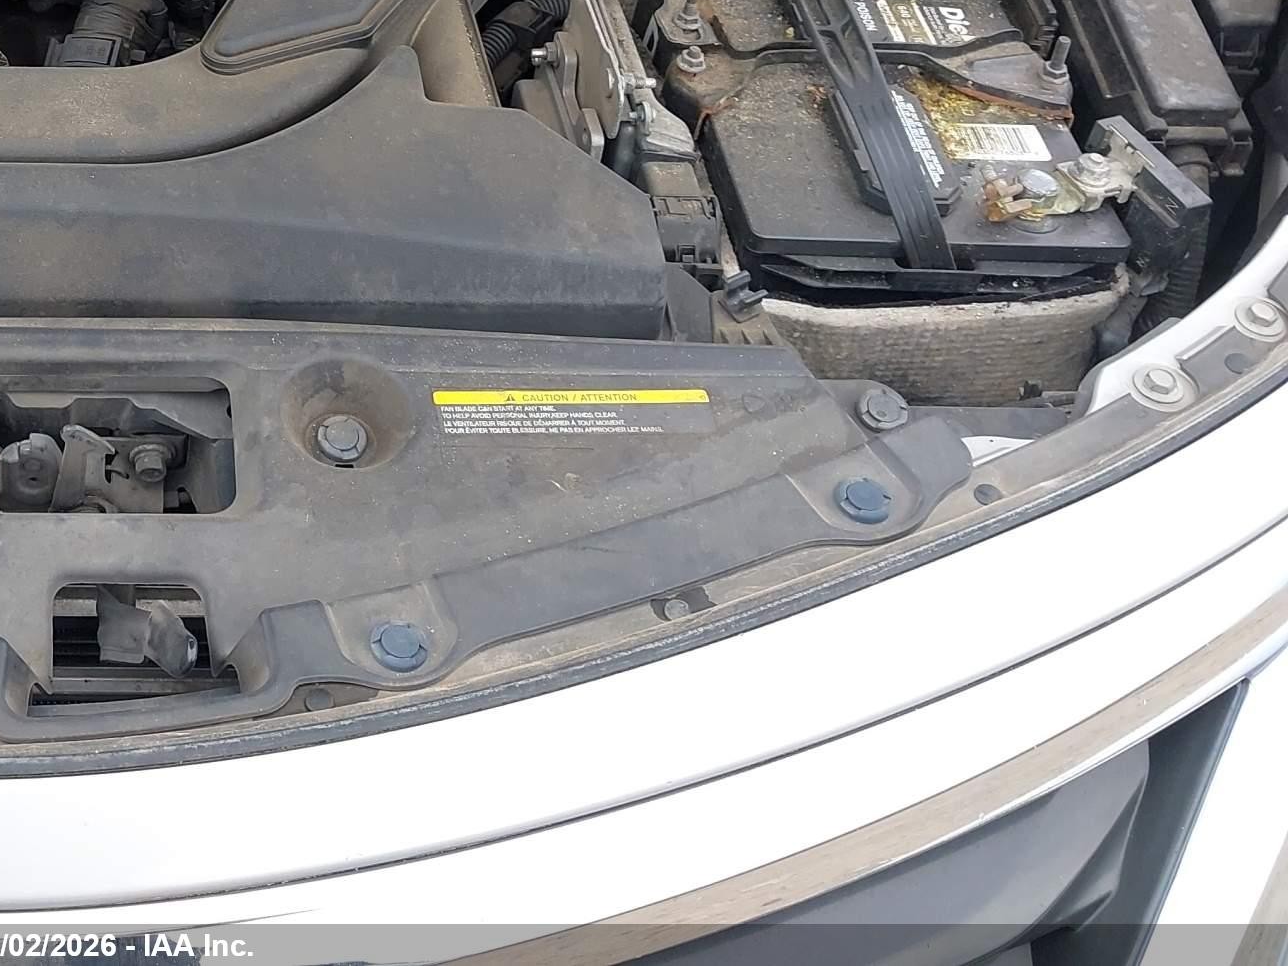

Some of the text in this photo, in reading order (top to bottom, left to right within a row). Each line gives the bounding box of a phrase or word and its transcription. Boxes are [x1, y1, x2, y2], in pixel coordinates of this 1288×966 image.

[854, 1, 879, 31] POISON
[522, 394, 569, 402] CAUTION
[580, 393, 638, 402] ATTENTION
